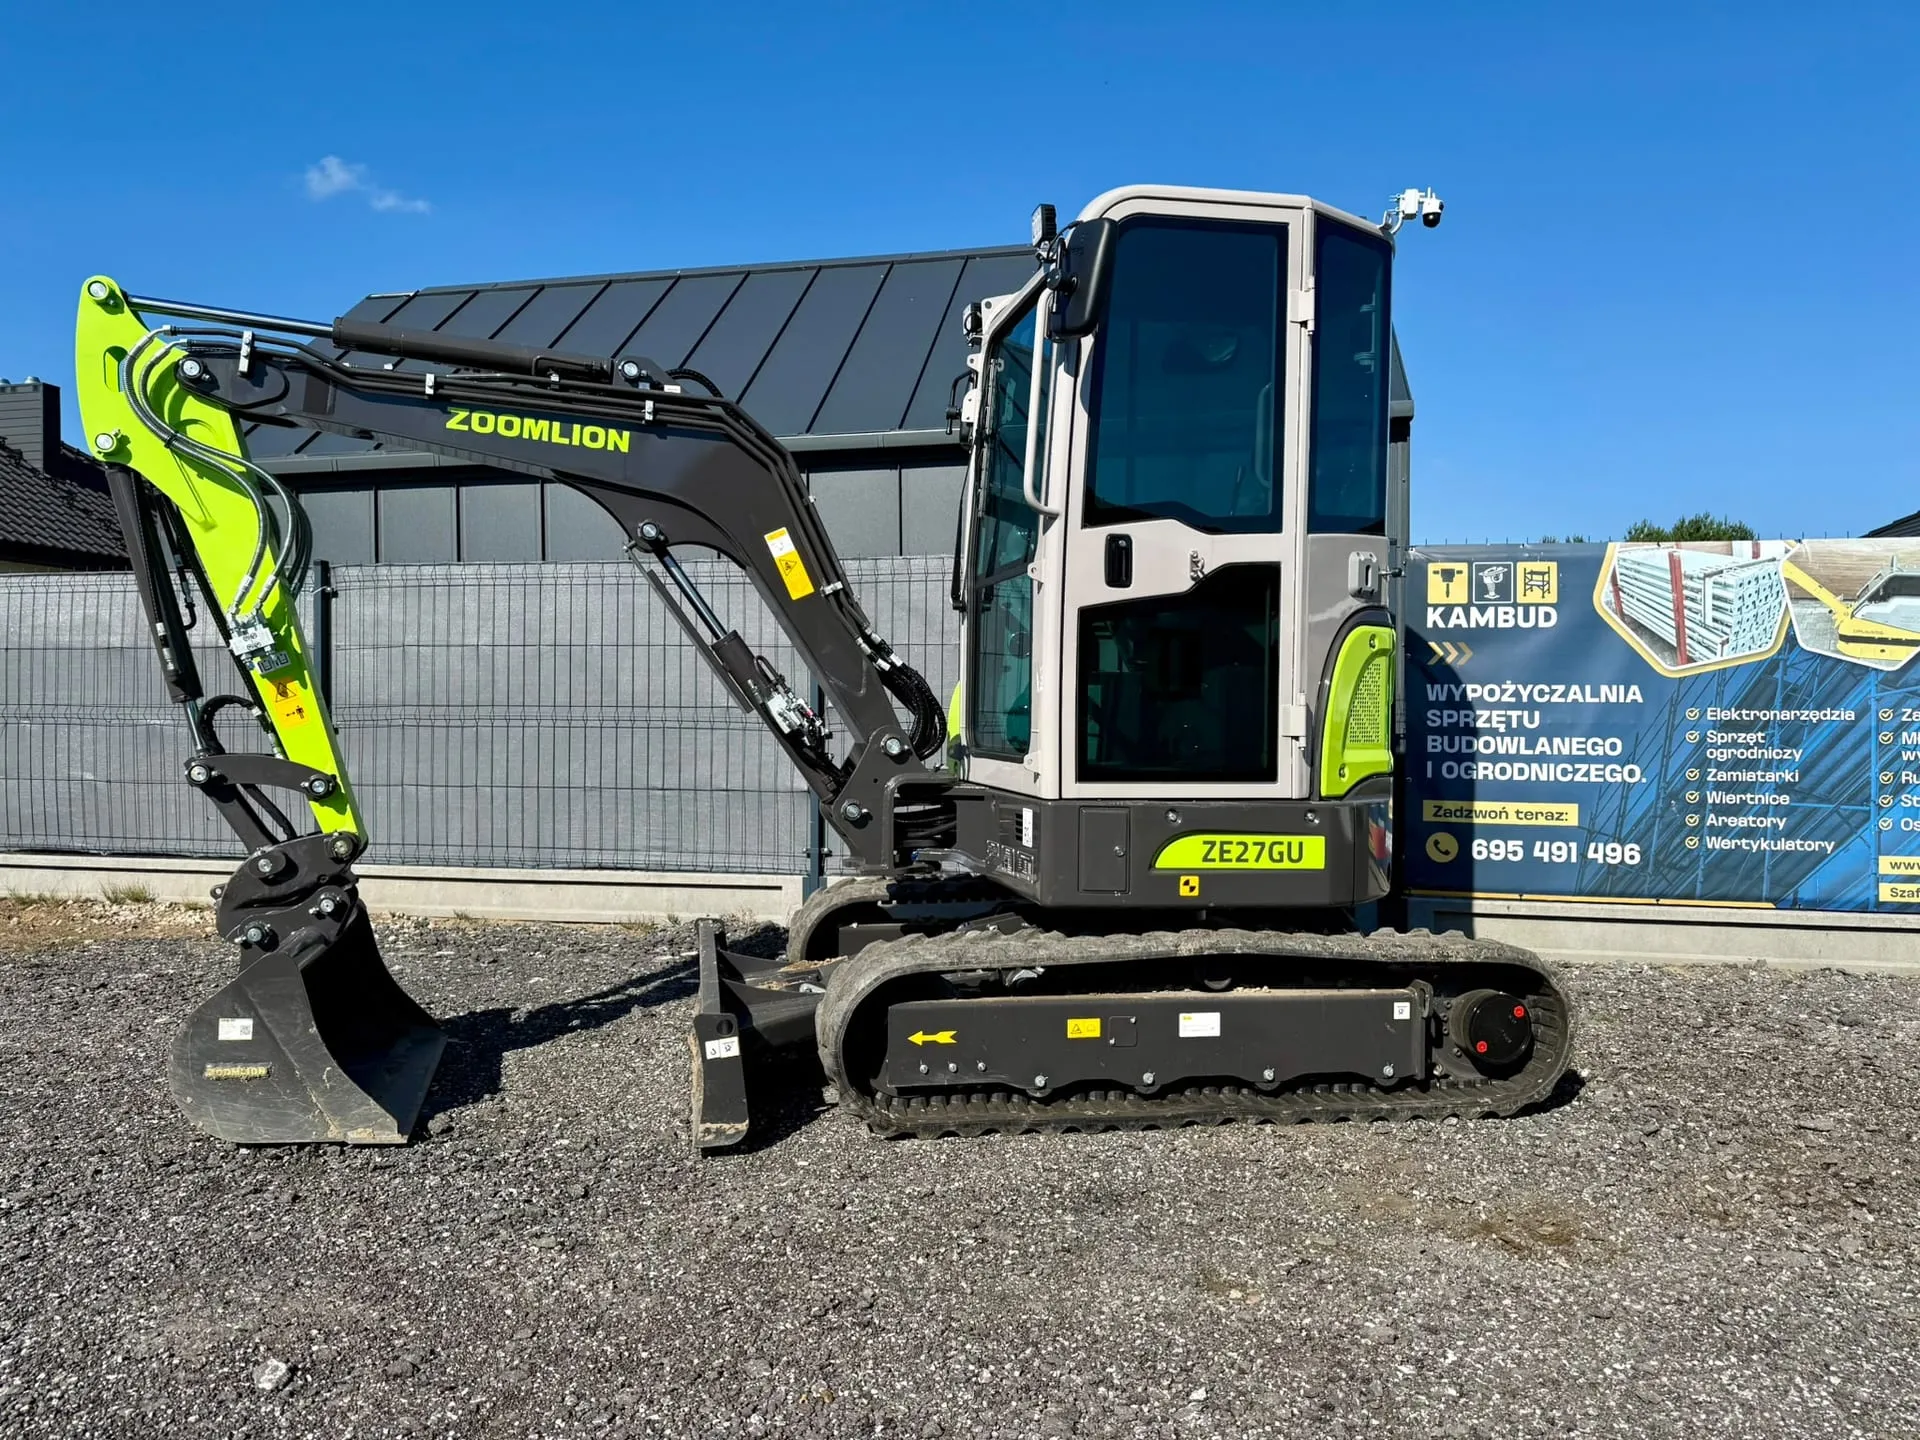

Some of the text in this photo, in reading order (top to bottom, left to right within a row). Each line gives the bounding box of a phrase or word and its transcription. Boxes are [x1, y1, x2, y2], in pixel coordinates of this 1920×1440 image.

[446, 407, 630, 452] ZOOMLION
[1426, 606, 1558, 628] KAMBUD
[1426, 680, 1643, 703] WYPOŻYCZALNIA
[1426, 709, 1540, 732] SPRZĘTU
[1706, 707, 1856, 723] Elektronarzędzia
[1426, 736, 1623, 756] BUDOWLANEGO
[1706, 730, 1765, 745] Sprzęt
[1706, 747, 1803, 761] ogrodniczy
[1426, 760, 1647, 783] I OGRODNICZEGO.
[1706, 768, 1799, 782] Zamiatarki
[1706, 791, 1790, 805] Wiertnice
[1432, 805, 1569, 822] Zadzwoń teraz:
[1706, 814, 1787, 830] Areatory
[1201, 840, 1304, 864] ZE27GU
[1471, 839, 1642, 865] 695 491 496
[1706, 836, 1836, 854] Wertykulatory
